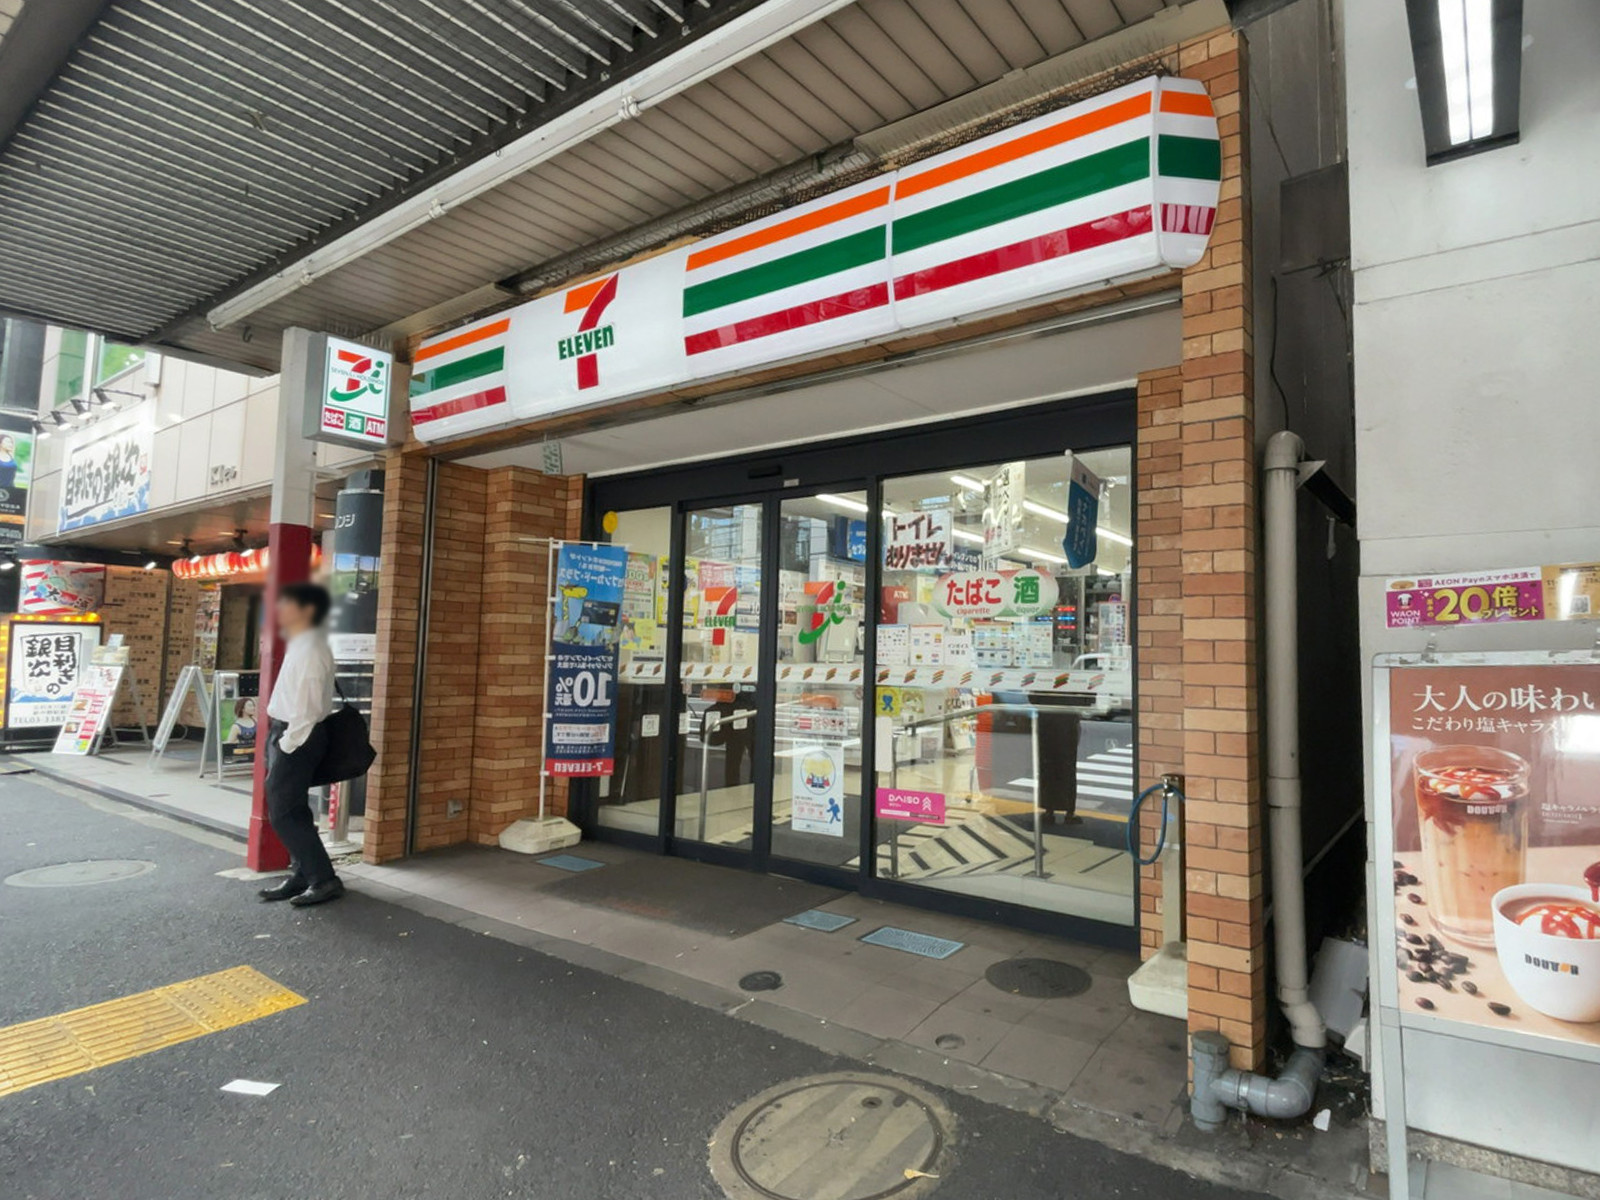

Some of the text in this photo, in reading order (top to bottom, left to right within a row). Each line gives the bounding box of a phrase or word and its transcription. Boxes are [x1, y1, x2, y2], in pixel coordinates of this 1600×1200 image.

[563, 272, 619, 390] 7
[892, 513, 944, 541] トイレ
[947, 575, 1040, 606] たばこ 酒
[1434, 587, 1490, 621] 20
[1492, 585, 1518, 608] 倍
[704, 586, 738, 646] 7
[956, 606, 991, 615] cigarette
[1390, 609, 1421, 618] WAON
[1482, 607, 1539, 619] プレゼント
[25, 635, 52, 678] 銀次
[888, 793, 920, 805] DAISO
